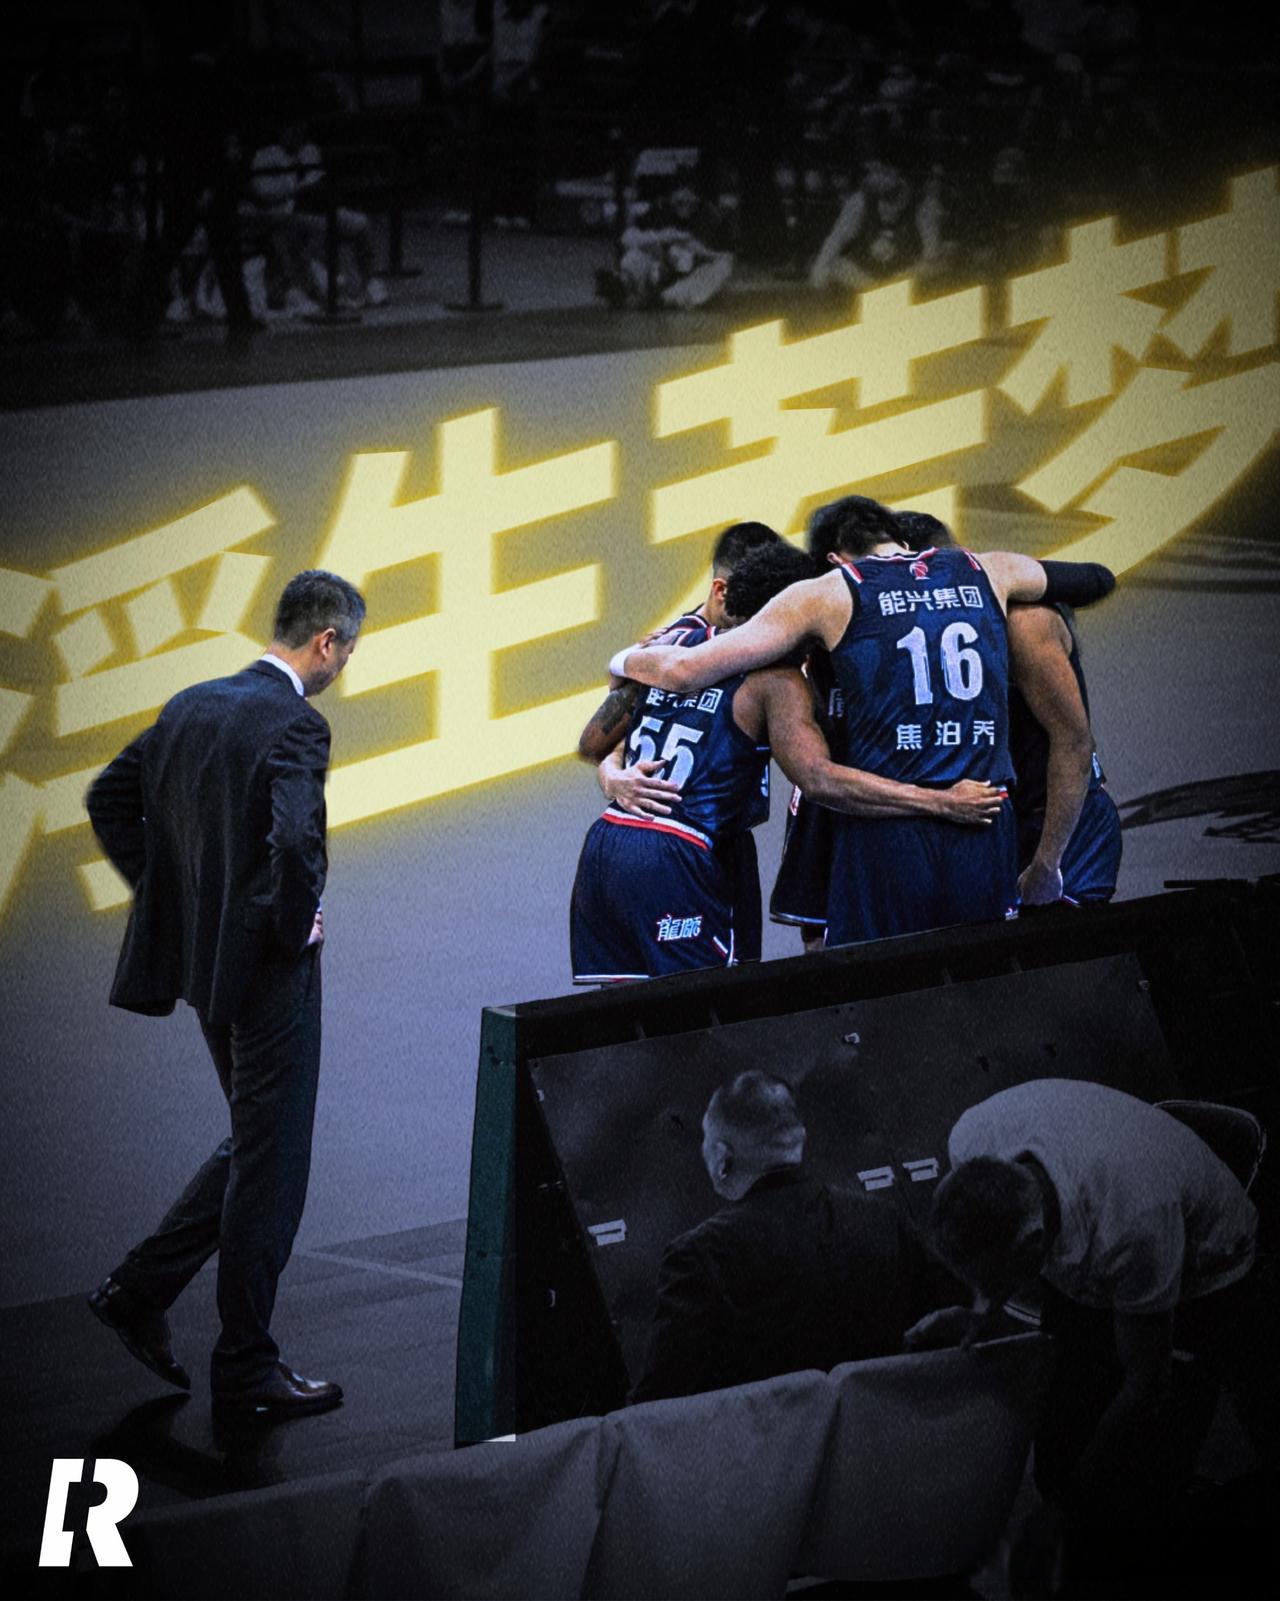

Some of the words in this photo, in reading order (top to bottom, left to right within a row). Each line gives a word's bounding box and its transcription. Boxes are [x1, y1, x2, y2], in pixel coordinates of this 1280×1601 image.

[878, 585, 983, 616] 能兴集团
[896, 621, 983, 705] 16
[629, 715, 704, 790] 55
[896, 720, 995, 750] 焦泊乔
